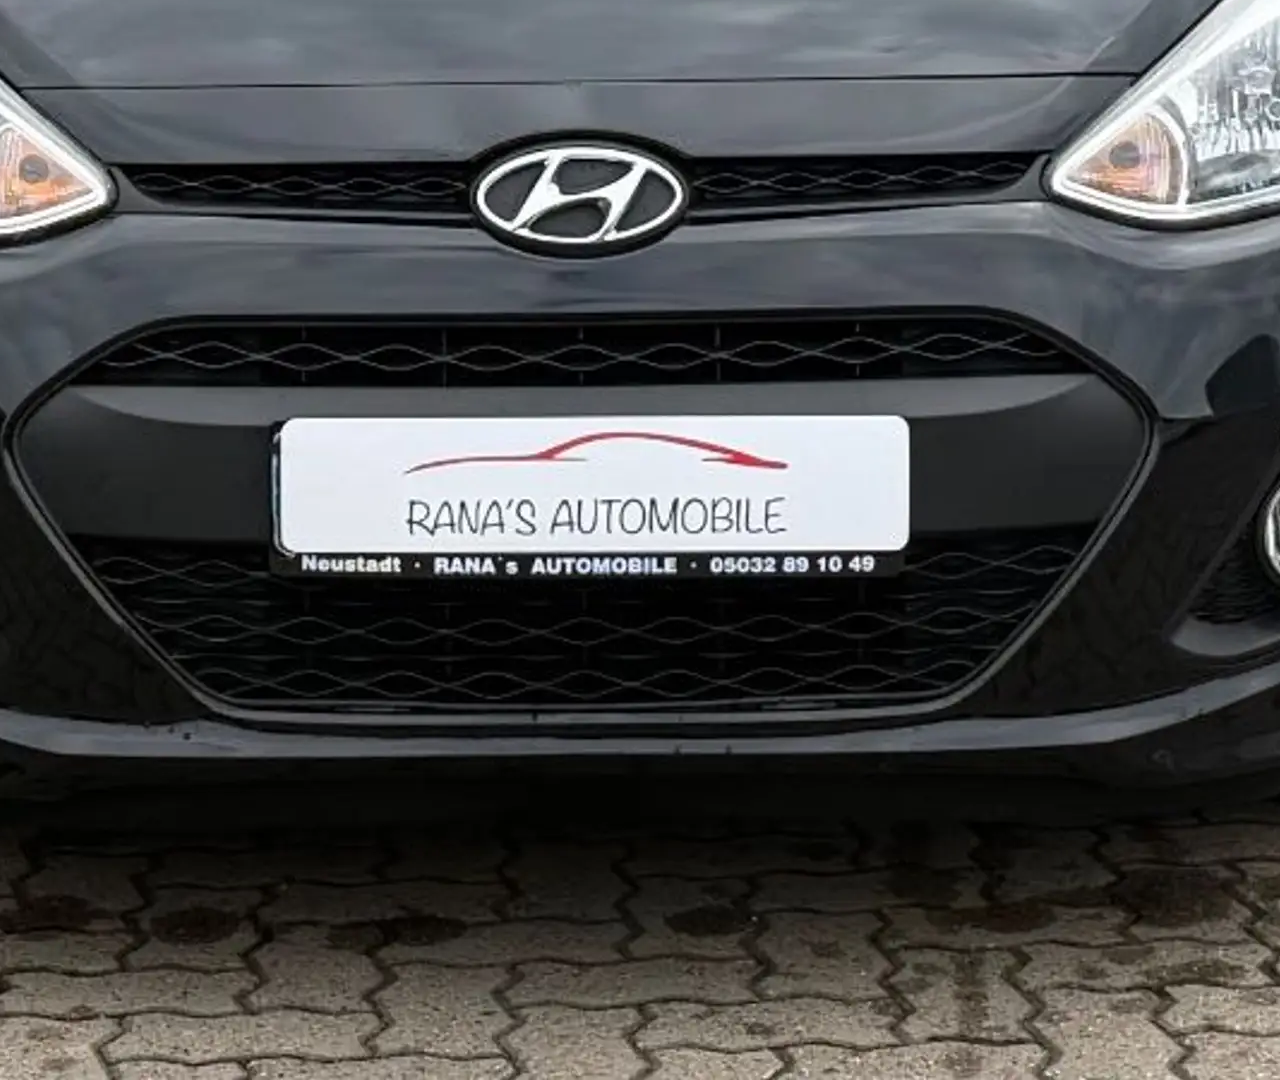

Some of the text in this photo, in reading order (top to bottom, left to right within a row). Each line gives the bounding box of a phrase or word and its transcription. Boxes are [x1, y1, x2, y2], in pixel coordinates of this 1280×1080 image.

[407, 497, 788, 536] RANA'S AUTOMOBILE
[301, 554, 402, 573] Neustadt
[531, 557, 678, 575] AUTOMOBILE
[710, 556, 777, 574] 05032
[782, 556, 810, 573] 89
[817, 555, 843, 573] 10
[848, 555, 875, 573] 49
